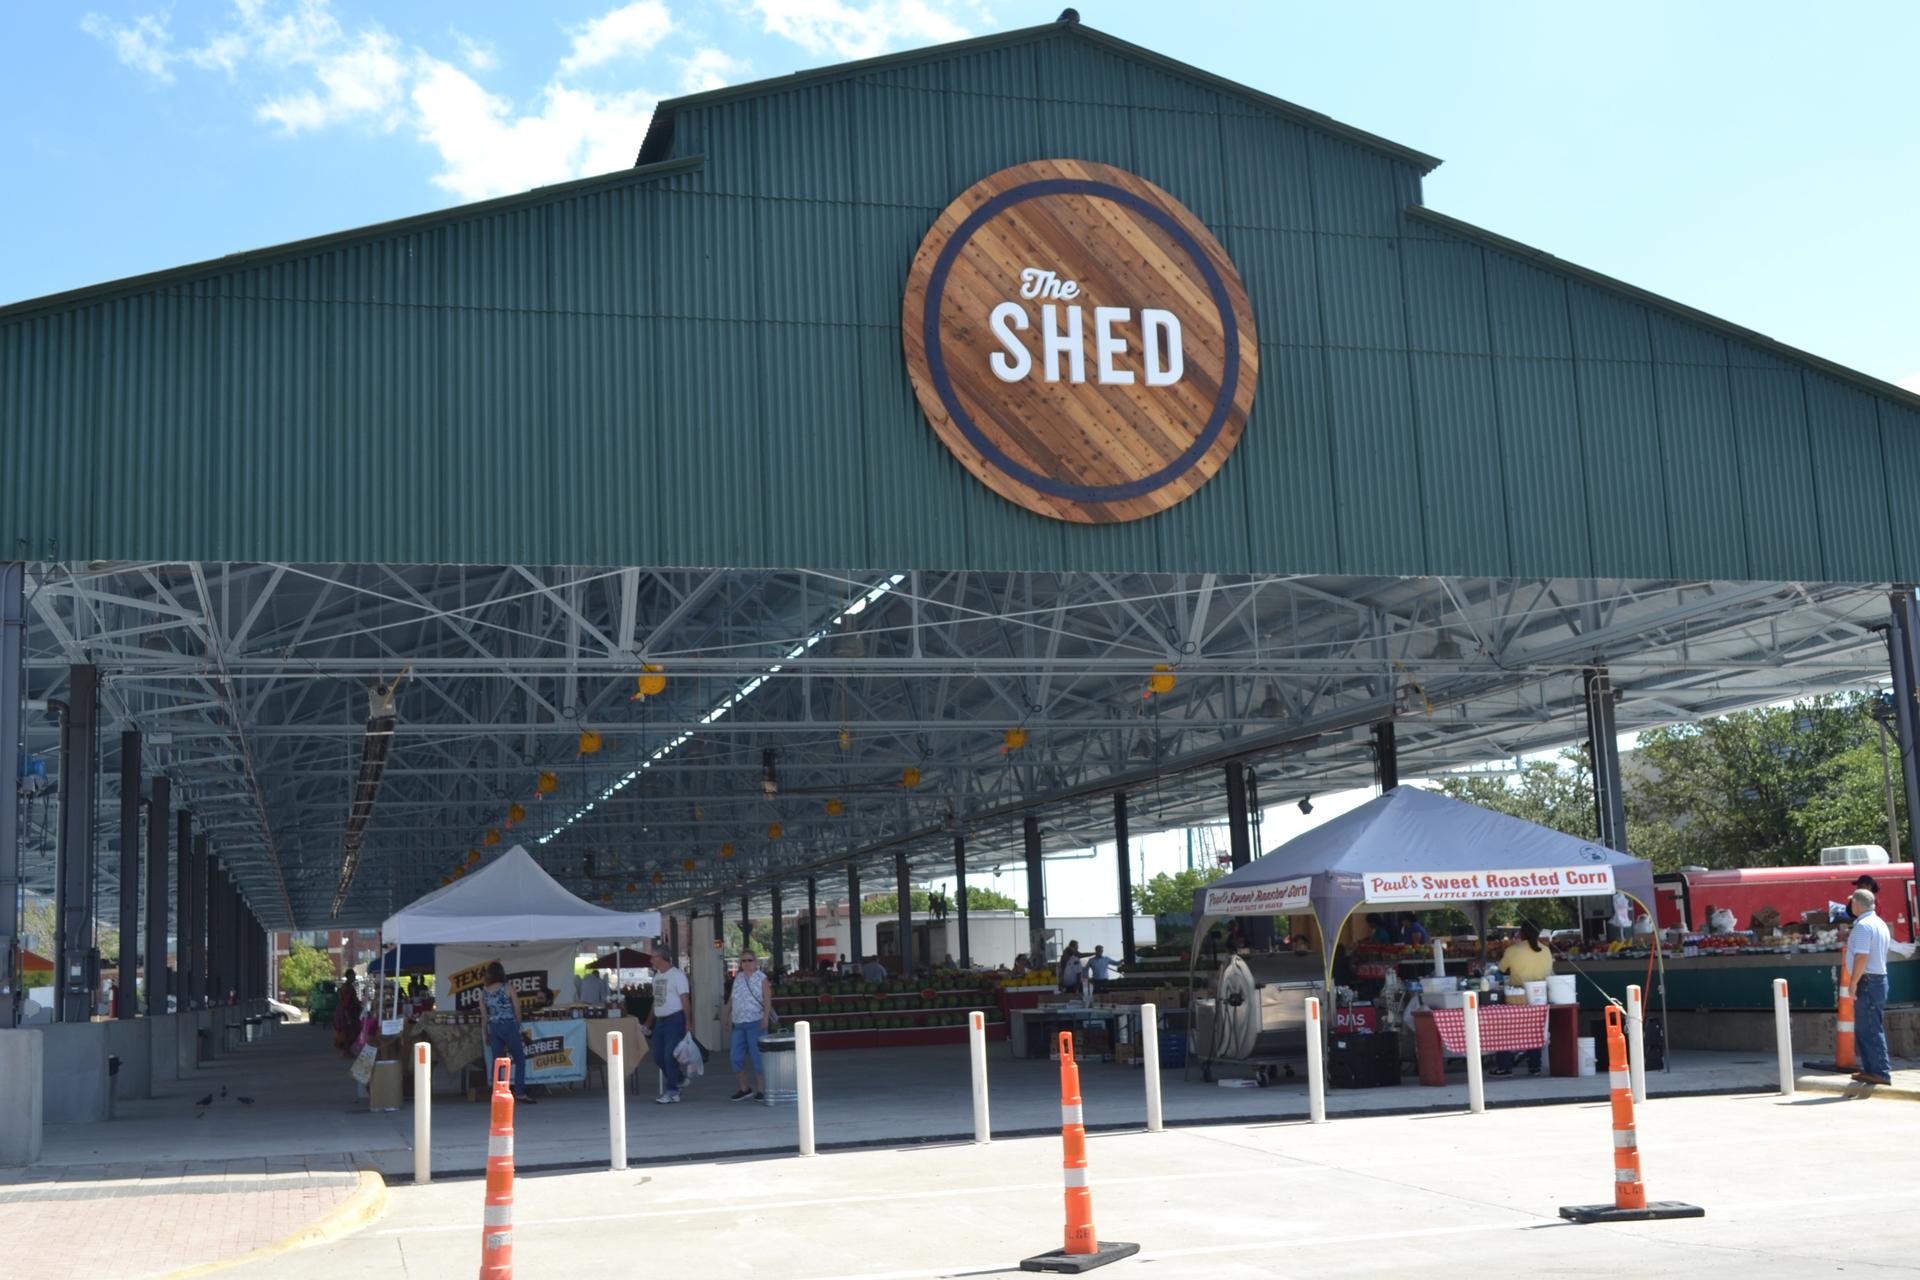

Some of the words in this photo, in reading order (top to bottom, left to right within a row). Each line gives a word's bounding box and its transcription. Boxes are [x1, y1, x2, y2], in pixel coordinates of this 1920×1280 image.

[1020, 267, 1080, 300] The
[989, 302, 1184, 387] SHED
[1371, 875, 1418, 893] Paul's
[1422, 874, 1479, 890] Sweet
[1486, 871, 1560, 889] Roasted
[1565, 870, 1608, 886] Corn
[1423, 892, 1431, 900] A
[1434, 891, 1467, 899] LITTLE
[1472, 890, 1500, 898] TASTE
[1503, 889, 1516, 897] OF
[1519, 887, 1560, 896] HEAVEN
